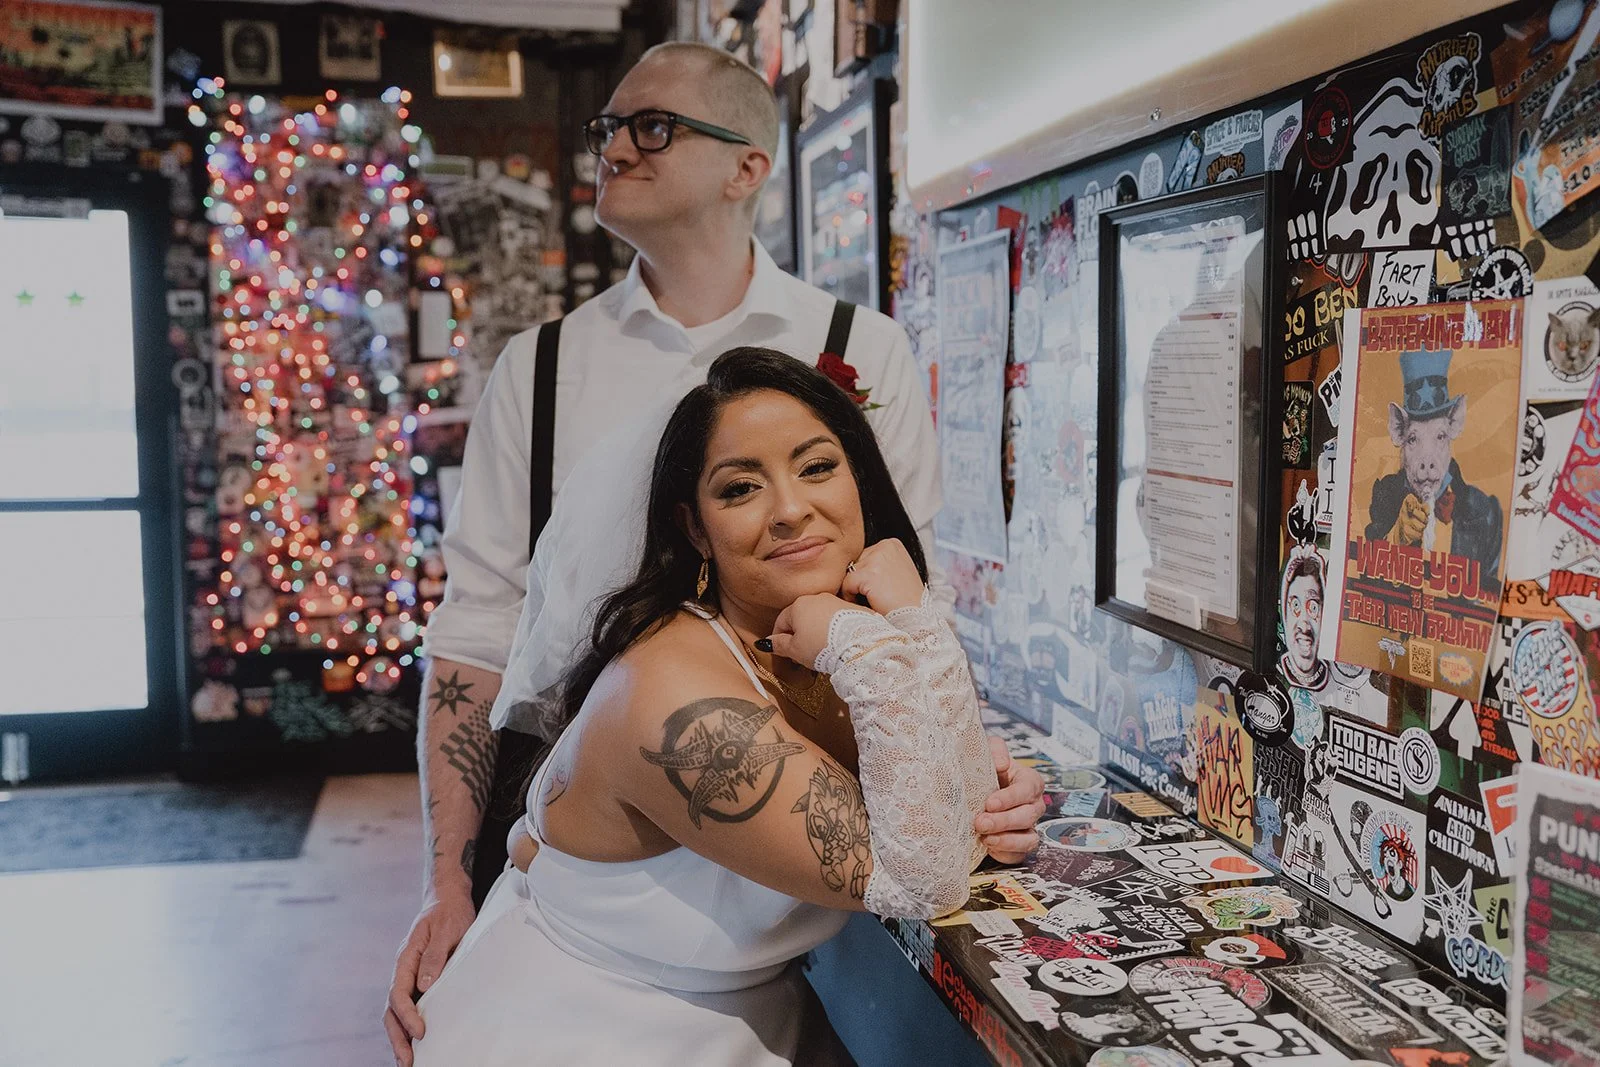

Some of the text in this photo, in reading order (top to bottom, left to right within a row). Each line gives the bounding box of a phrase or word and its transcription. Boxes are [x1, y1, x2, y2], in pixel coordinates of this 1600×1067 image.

[1420, 36, 1478, 82] MURDER
[1379, 250, 1426, 287] FART
[1297, 329, 1330, 355] FUCK
[1357, 536, 1424, 590] WANTS
[1334, 723, 1399, 767] TOO BAD
[1334, 744, 1400, 790] EUGENE
[1540, 815, 1600, 863] PUN
[1130, 904, 1186, 940] RUSSO
[1054, 959, 1115, 991] GAMUT
